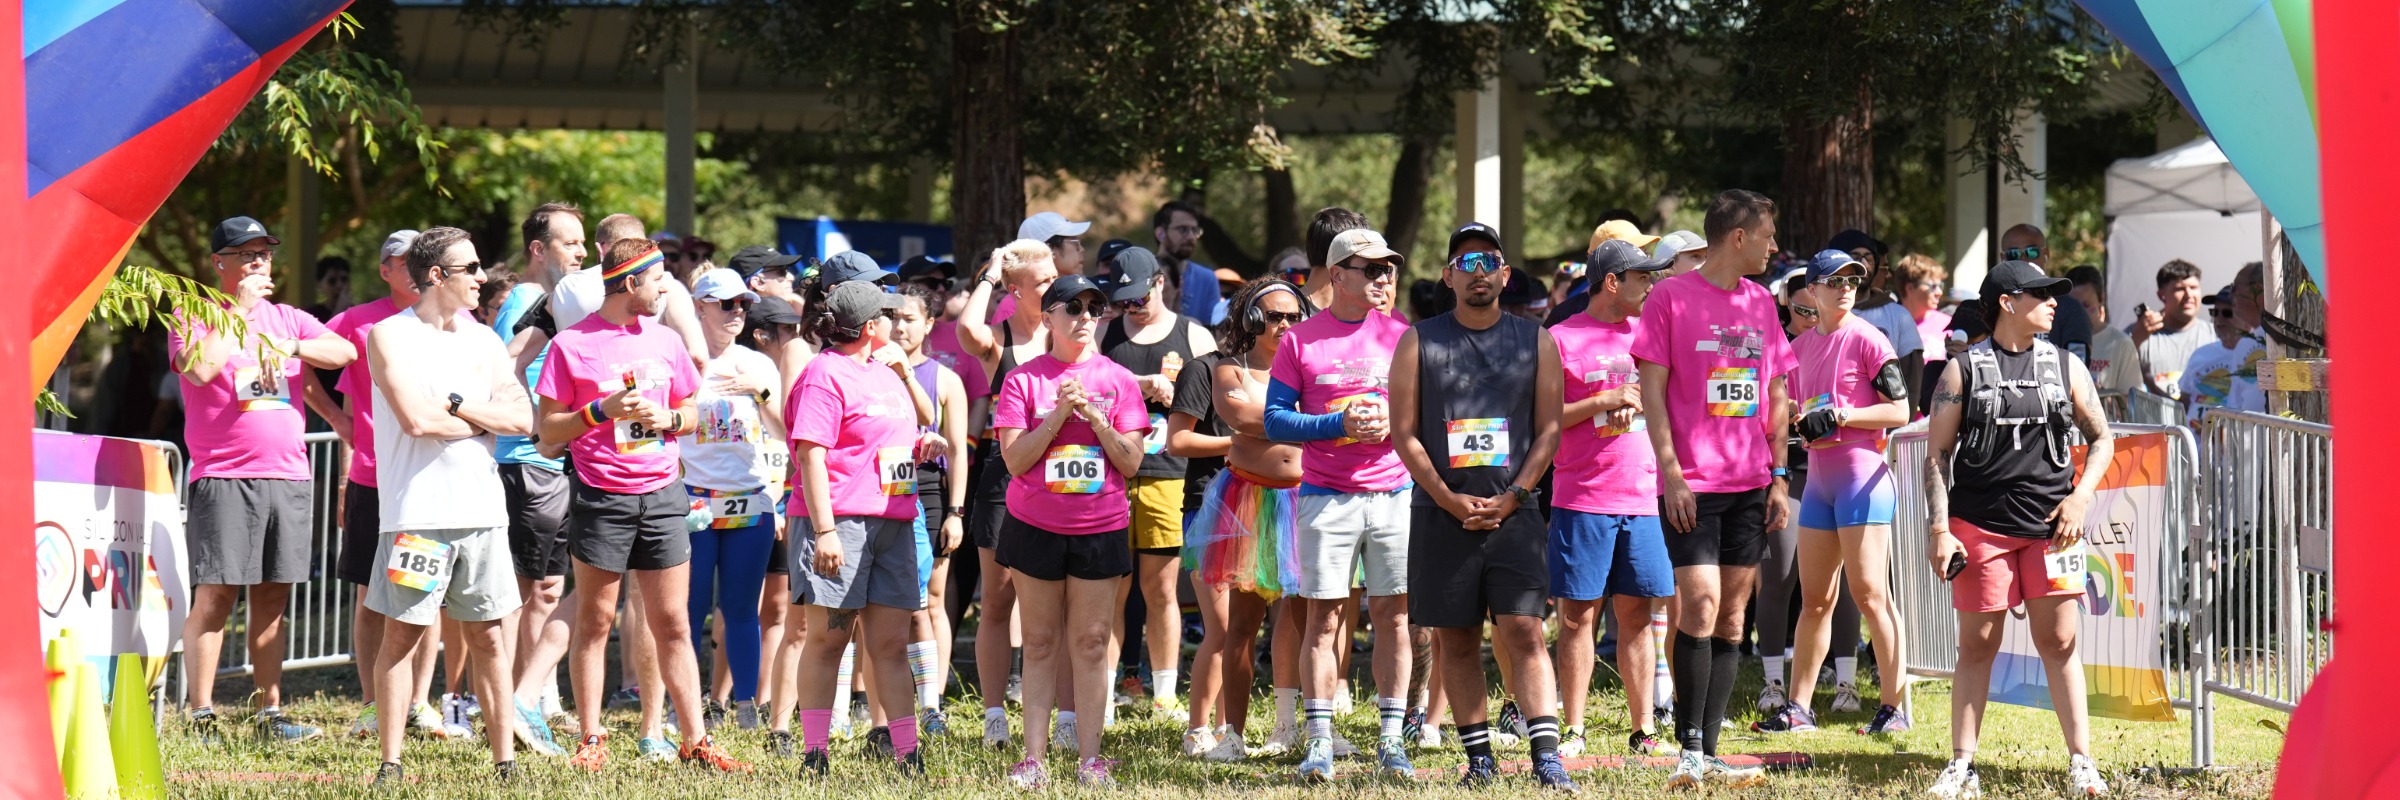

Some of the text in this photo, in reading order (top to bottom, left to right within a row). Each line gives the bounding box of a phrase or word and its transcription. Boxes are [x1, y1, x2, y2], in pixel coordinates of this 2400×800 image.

[1717, 383, 1755, 401] 158
[1463, 434, 1495, 451] 43
[888, 462, 914, 480] 107
[1054, 460, 1098, 478] 106
[724, 498, 748, 515] 27
[84, 518, 133, 542] SILCON
[2083, 521, 2135, 546] ALLEY
[399, 551, 440, 577] 185
